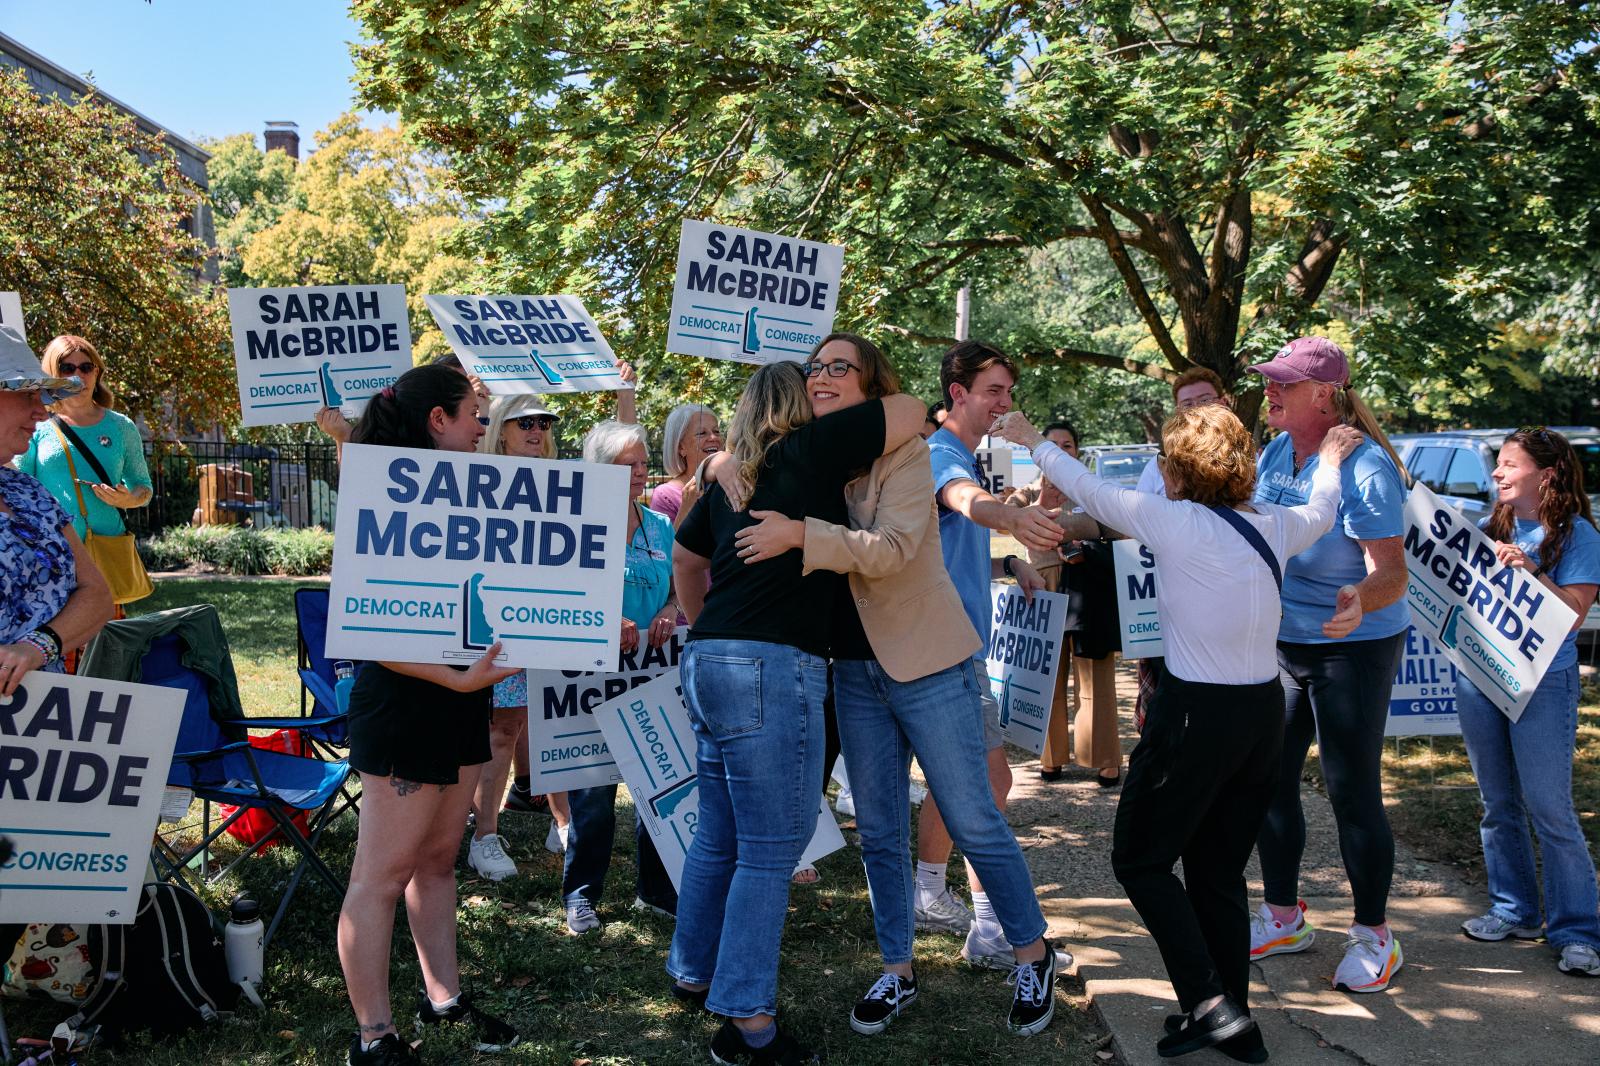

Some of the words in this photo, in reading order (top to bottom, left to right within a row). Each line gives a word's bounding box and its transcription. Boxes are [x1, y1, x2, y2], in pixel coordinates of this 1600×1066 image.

[707, 230, 819, 276] SARAH
[686, 260, 829, 311] McBRIDE
[258, 291, 381, 325] SARAH
[454, 299, 568, 321] SARAH
[246, 323, 400, 360] McBRIDE
[452, 322, 596, 346] McBRIDE
[679, 315, 742, 334] DEMOCRAT
[765, 328, 821, 346] CONGRESS
[474, 363, 535, 374] DEMOCRAT
[557, 360, 613, 371] CONGRESS
[249, 382, 318, 398] DEMOCRAT
[386, 457, 585, 516] SARAH
[1271, 471, 1312, 493] SARAH
[355, 508, 608, 569] McBRIDE
[1430, 509, 1544, 621] SARAH
[345, 596, 457, 620] DEMOCRAT
[501, 605, 605, 628] CONGRESS
[1404, 524, 1545, 663] McBRIDE
[994, 592, 1052, 634] SARAH
[1407, 582, 1445, 620] OCRAT
[1463, 635, 1521, 693] CONGRESS
[1012, 698, 1045, 720] CONGRESS
[630, 699, 679, 782] DEMOCRAT
